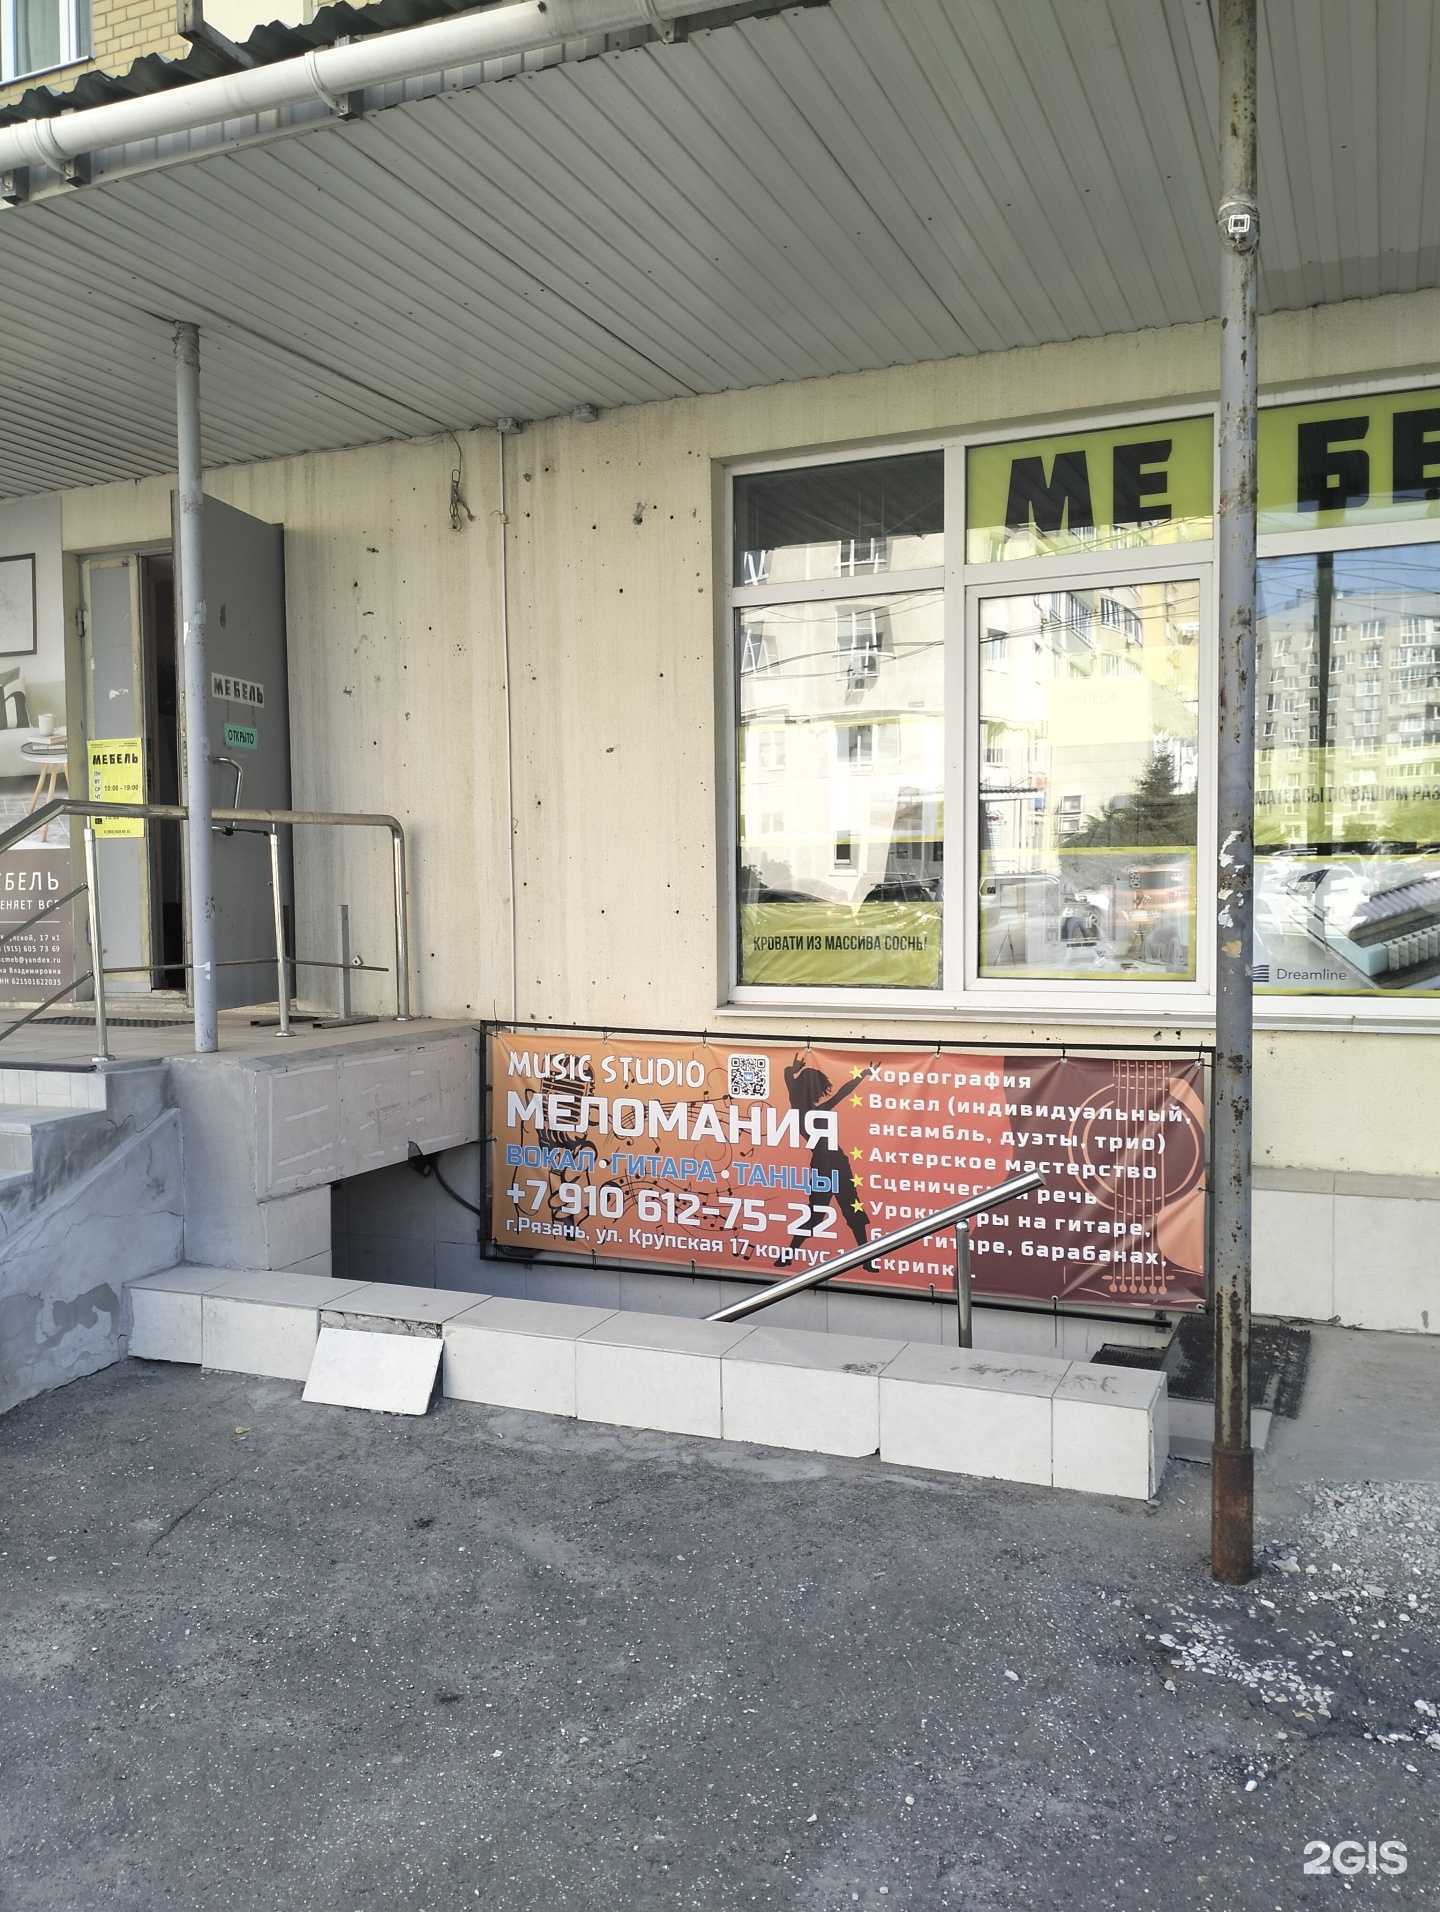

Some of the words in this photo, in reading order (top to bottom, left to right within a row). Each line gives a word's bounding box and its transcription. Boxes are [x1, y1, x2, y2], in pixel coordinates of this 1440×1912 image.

[214, 677, 263, 704] МЕБЕЛЬ
[227, 729, 254, 745] ОТКРЫТО
[92, 753, 138, 765] МЕБЕЛЬ
[0, 871, 60, 891] БЕЛЬ
[754, 935, 803, 951] КРОВАТИ
[807, 935, 822, 950] ИЗ
[824, 935, 882, 951] МАССИВА
[1276, 968, 1347, 982] Dreamline
[508, 1050, 593, 1083] MUSIC
[602, 1055, 706, 1088] STUDIO
[867, 1066, 1032, 1090] Хореография
[506, 1091, 839, 1151] МЕЛОМАНИЯ
[868, 1093, 941, 1113] Вокал
[947, 1097, 1192, 1125] (индивидуальный,
[868, 1123, 993, 1144] ансамбль,
[1000, 1131, 1086, 1150] дуэты,
[1094, 1134, 1167, 1155] трио)
[505, 1144, 595, 1173] ВОКАЛ
[611, 1152, 717, 1184] ГИТАРА
[732, 1161, 840, 1195] ТАНЦЫ
[869, 1147, 997, 1172] Актерское
[1004, 1159, 1158, 1180] мастерство
[869, 1174, 1029, 1200] Сценичес
[1037, 1190, 1097, 1208] речь
[506, 1180, 548, 1211] +7
[558, 1182, 625, 1220] 910
[637, 1189, 839, 1240] 612-75-22
[1018, 1215, 1046, 1230] на
[1055, 1218, 1152, 1240] гитаре,
[596, 1227, 622, 1245] ул.
[629, 1230, 723, 1254] Крупская
[730, 1238, 750, 1255] 17
[755, 1243, 830, 1266] корпус
[1020, 1240, 1168, 1268] барабанах,
[870, 1256, 977, 1280] скрипк.
